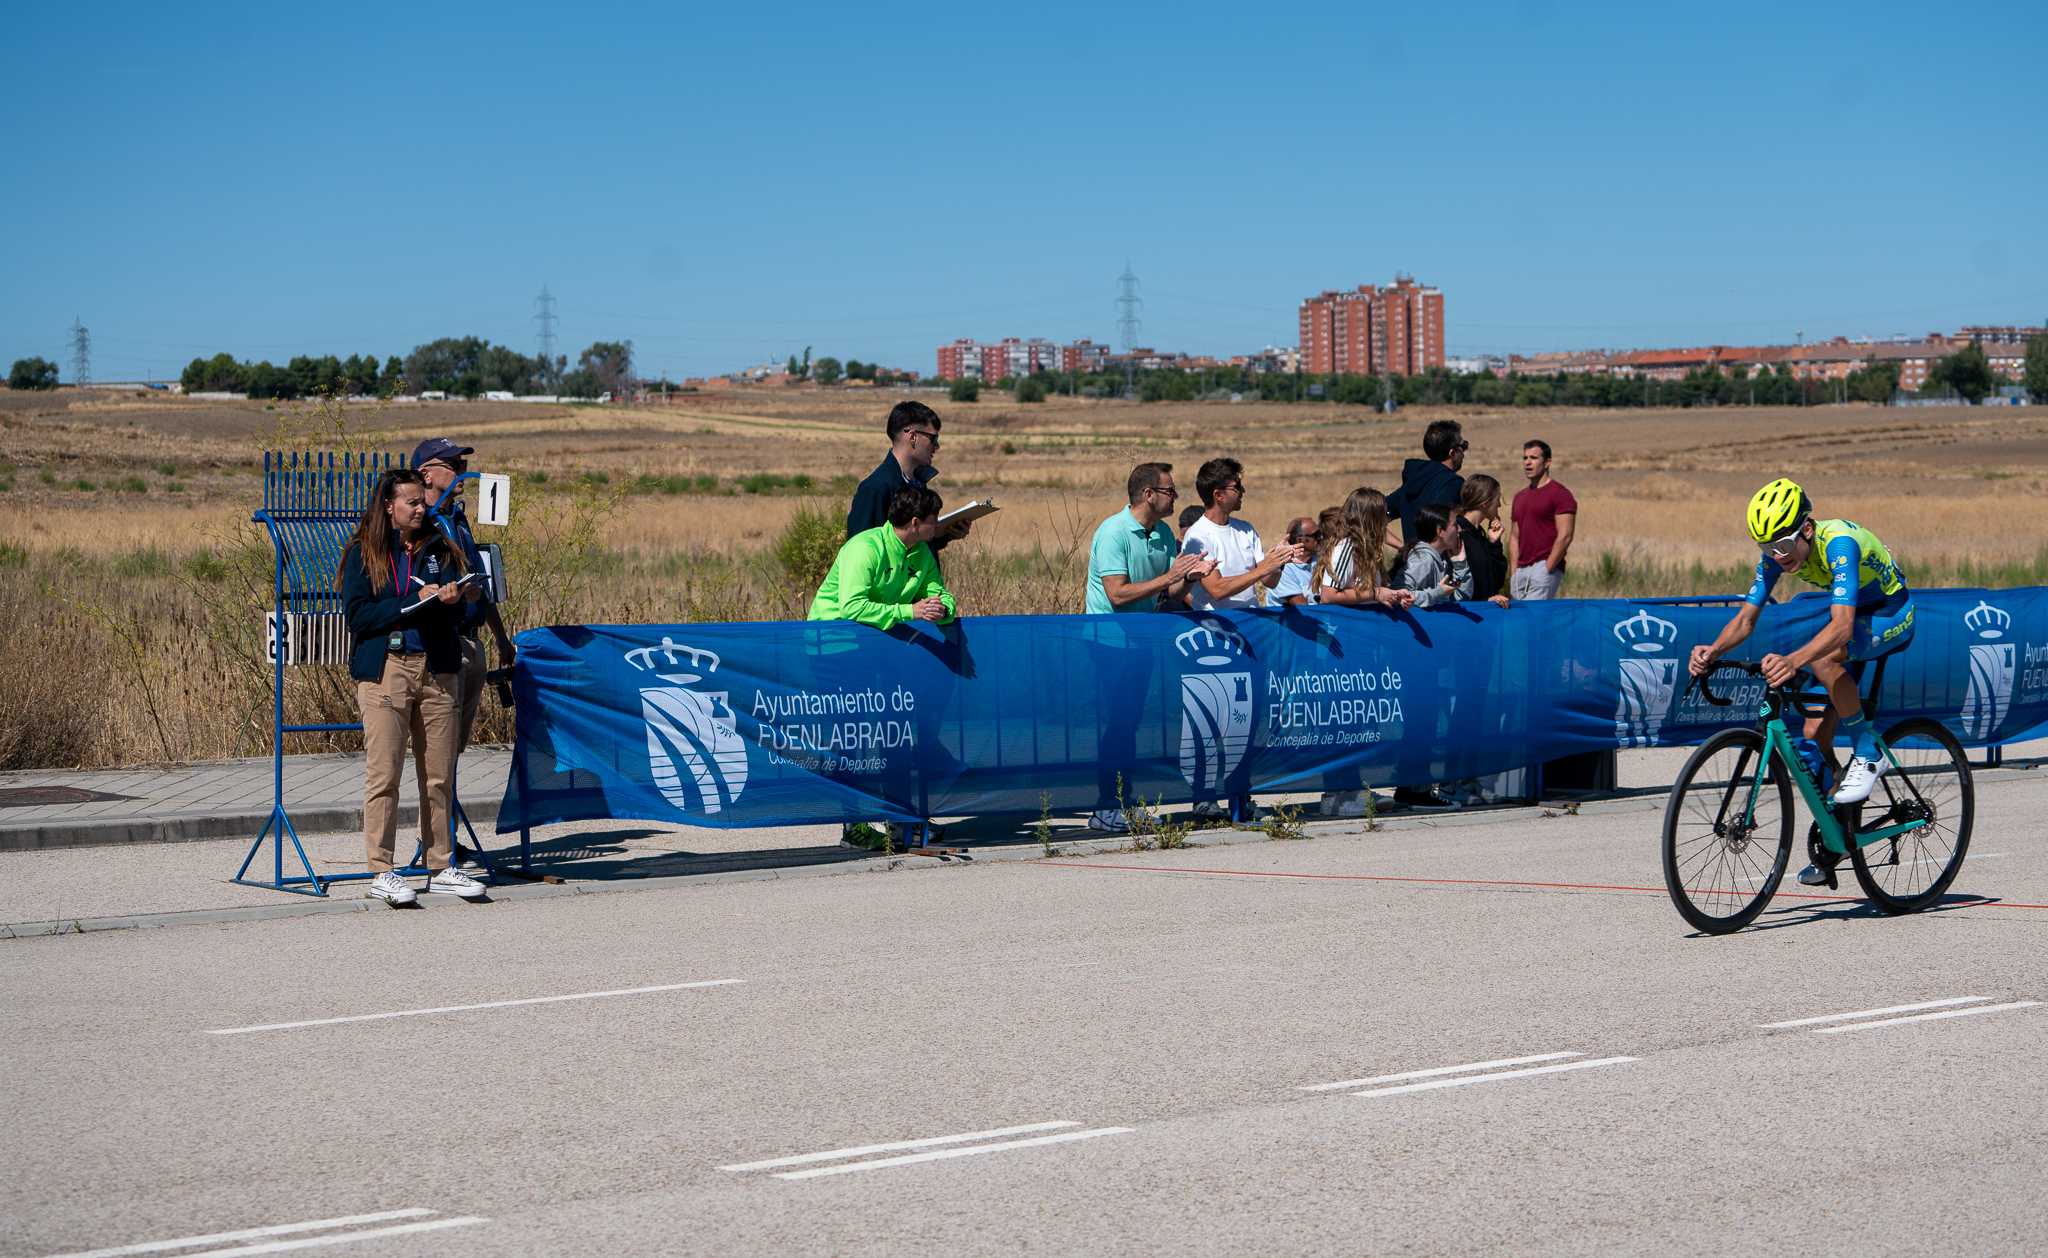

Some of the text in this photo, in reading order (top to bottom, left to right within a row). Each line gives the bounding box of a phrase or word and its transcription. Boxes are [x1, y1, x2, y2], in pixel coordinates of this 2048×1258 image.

[490, 481, 498, 522] 1
[1268, 666, 1402, 701] Ayuntamiento de
[751, 684, 915, 723] Ayuntamiento de
[1268, 698, 1404, 729] FUENLABRADA
[757, 720, 915, 751] FUENLABRADA
[1321, 731, 1334, 745] de
[1336, 730, 1381, 747] Deportes
[838, 755, 888, 773] Deportes
